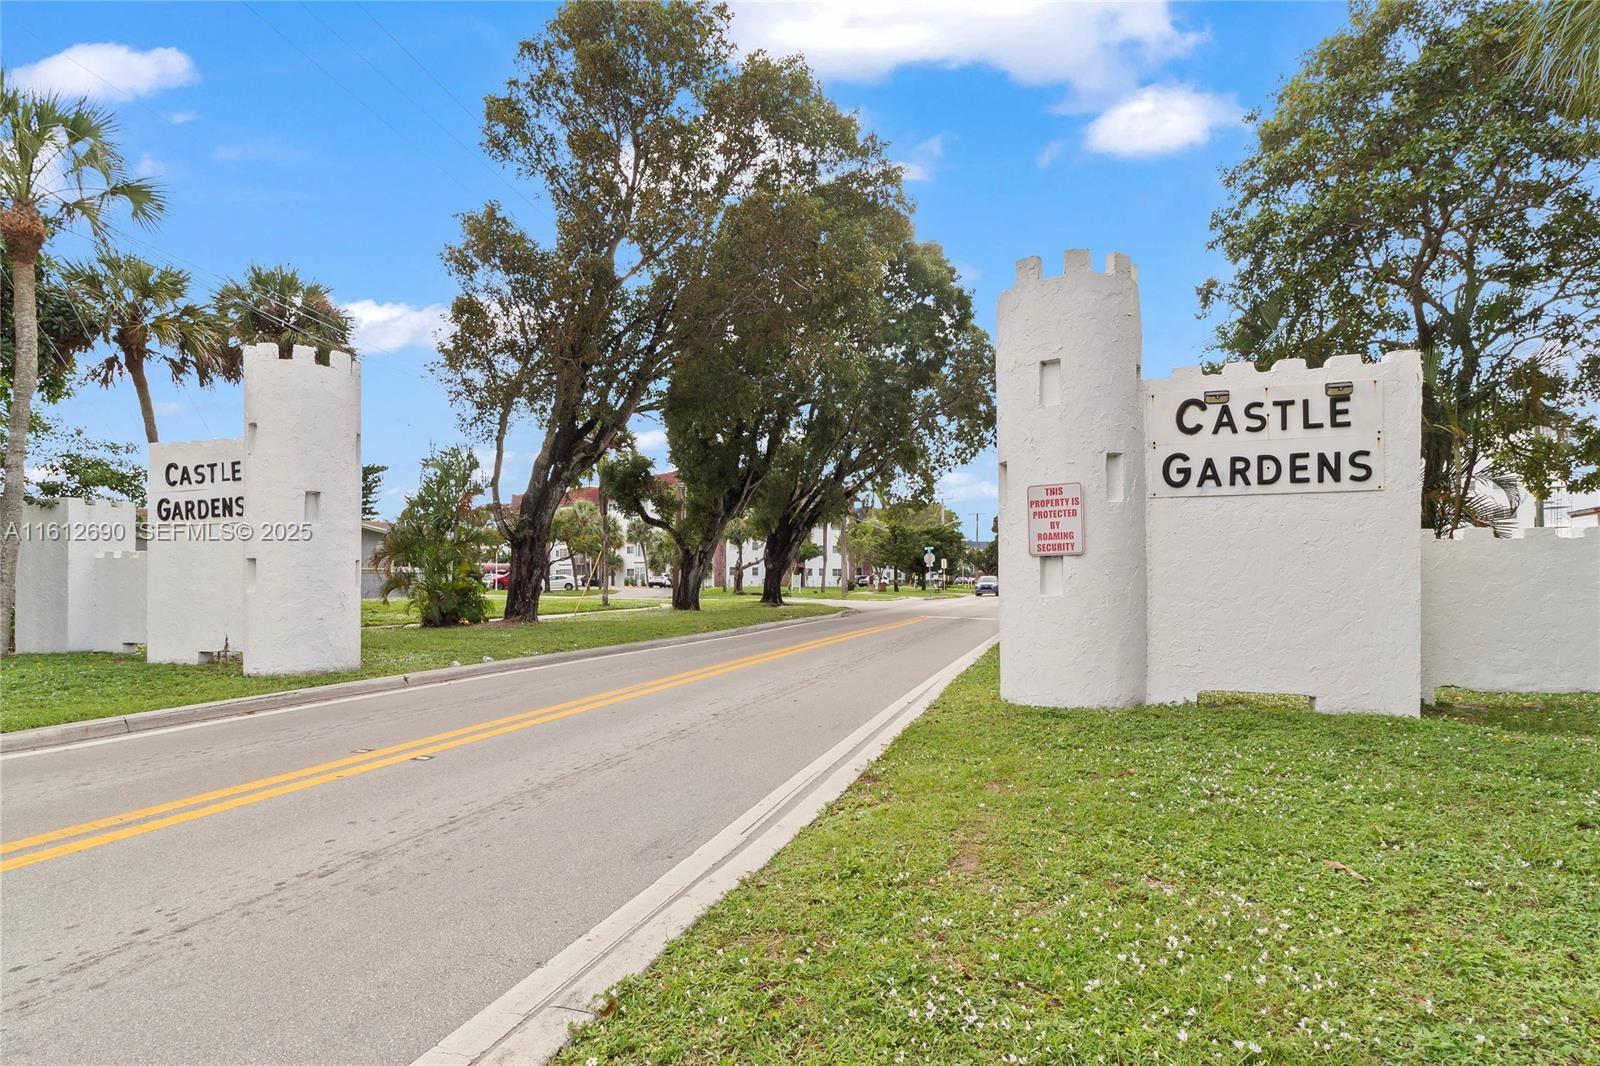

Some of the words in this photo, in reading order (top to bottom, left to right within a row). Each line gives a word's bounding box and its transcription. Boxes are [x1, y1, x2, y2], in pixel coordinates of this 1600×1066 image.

[1175, 396, 1351, 436] CASTLE
[165, 461, 242, 487] CASTLE
[1162, 450, 1372, 488] GARDENS
[1045, 487, 1063, 496] THIS
[1030, 498, 1069, 508] PROPERTY
[1071, 497, 1079, 505] IS
[157, 496, 244, 521] GARDENS
[1033, 509, 1077, 519] PROTECTED
[1050, 521, 1060, 529] BY
[1037, 532, 1074, 541] ROAMING
[1037, 543, 1075, 552] SECURITY
